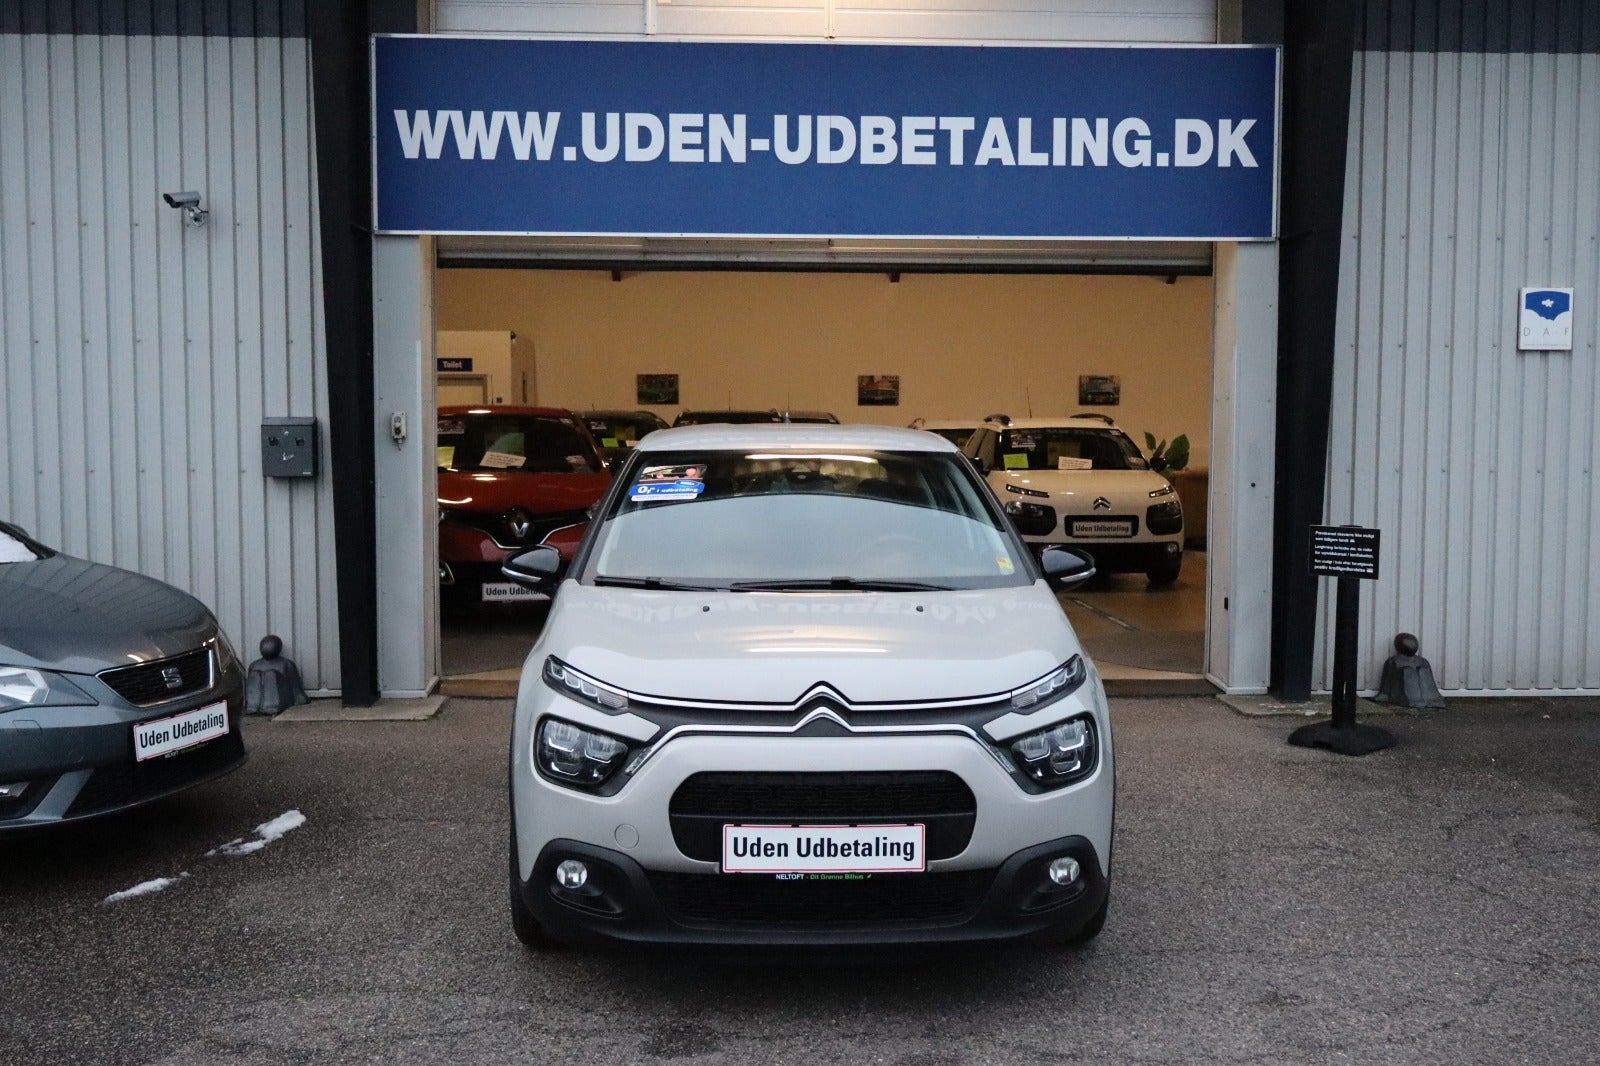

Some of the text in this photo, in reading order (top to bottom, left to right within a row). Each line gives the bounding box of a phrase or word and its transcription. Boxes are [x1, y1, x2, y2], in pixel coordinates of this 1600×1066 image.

[393, 109, 1259, 168] WWW.UDEN-UDBETALING.DK
[442, 360, 463, 369] Toilet
[1075, 524, 1129, 534] Uden Udbetaling
[485, 586, 507, 596] Uden
[140, 713, 225, 749] Uden Udbetaling
[733, 836, 915, 862] Uden Udbetaling
